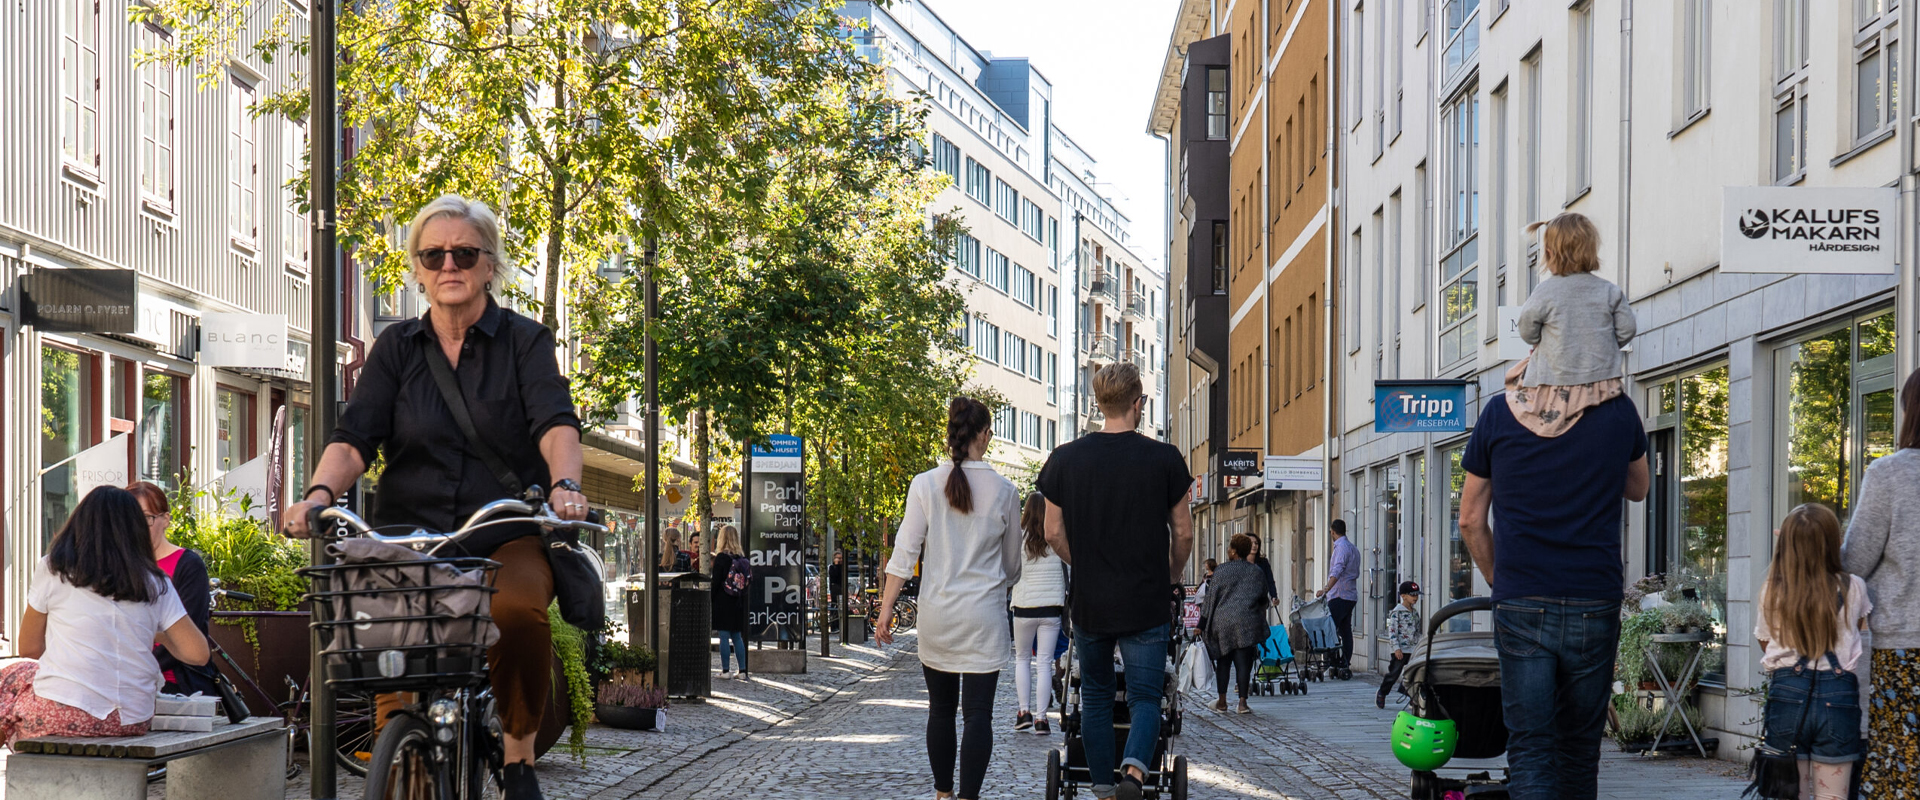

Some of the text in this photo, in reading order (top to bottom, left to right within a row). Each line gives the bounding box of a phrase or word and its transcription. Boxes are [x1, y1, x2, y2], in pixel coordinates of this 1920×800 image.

[1772, 209, 1880, 224] KALUFS
[1772, 226, 1880, 240] MAKARN
[1809, 242, 1880, 252] HÅRDESIGN
[37, 304, 82, 314] POLARN
[97, 305, 130, 315] PYRET
[1399, 394, 1453, 418] Tripp
[1417, 417, 1460, 427] RESEBYRÅ
[1223, 459, 1255, 468] LAKRITS
[82, 469, 122, 483] FRISÖR
[760, 532, 799, 540] Parkering
